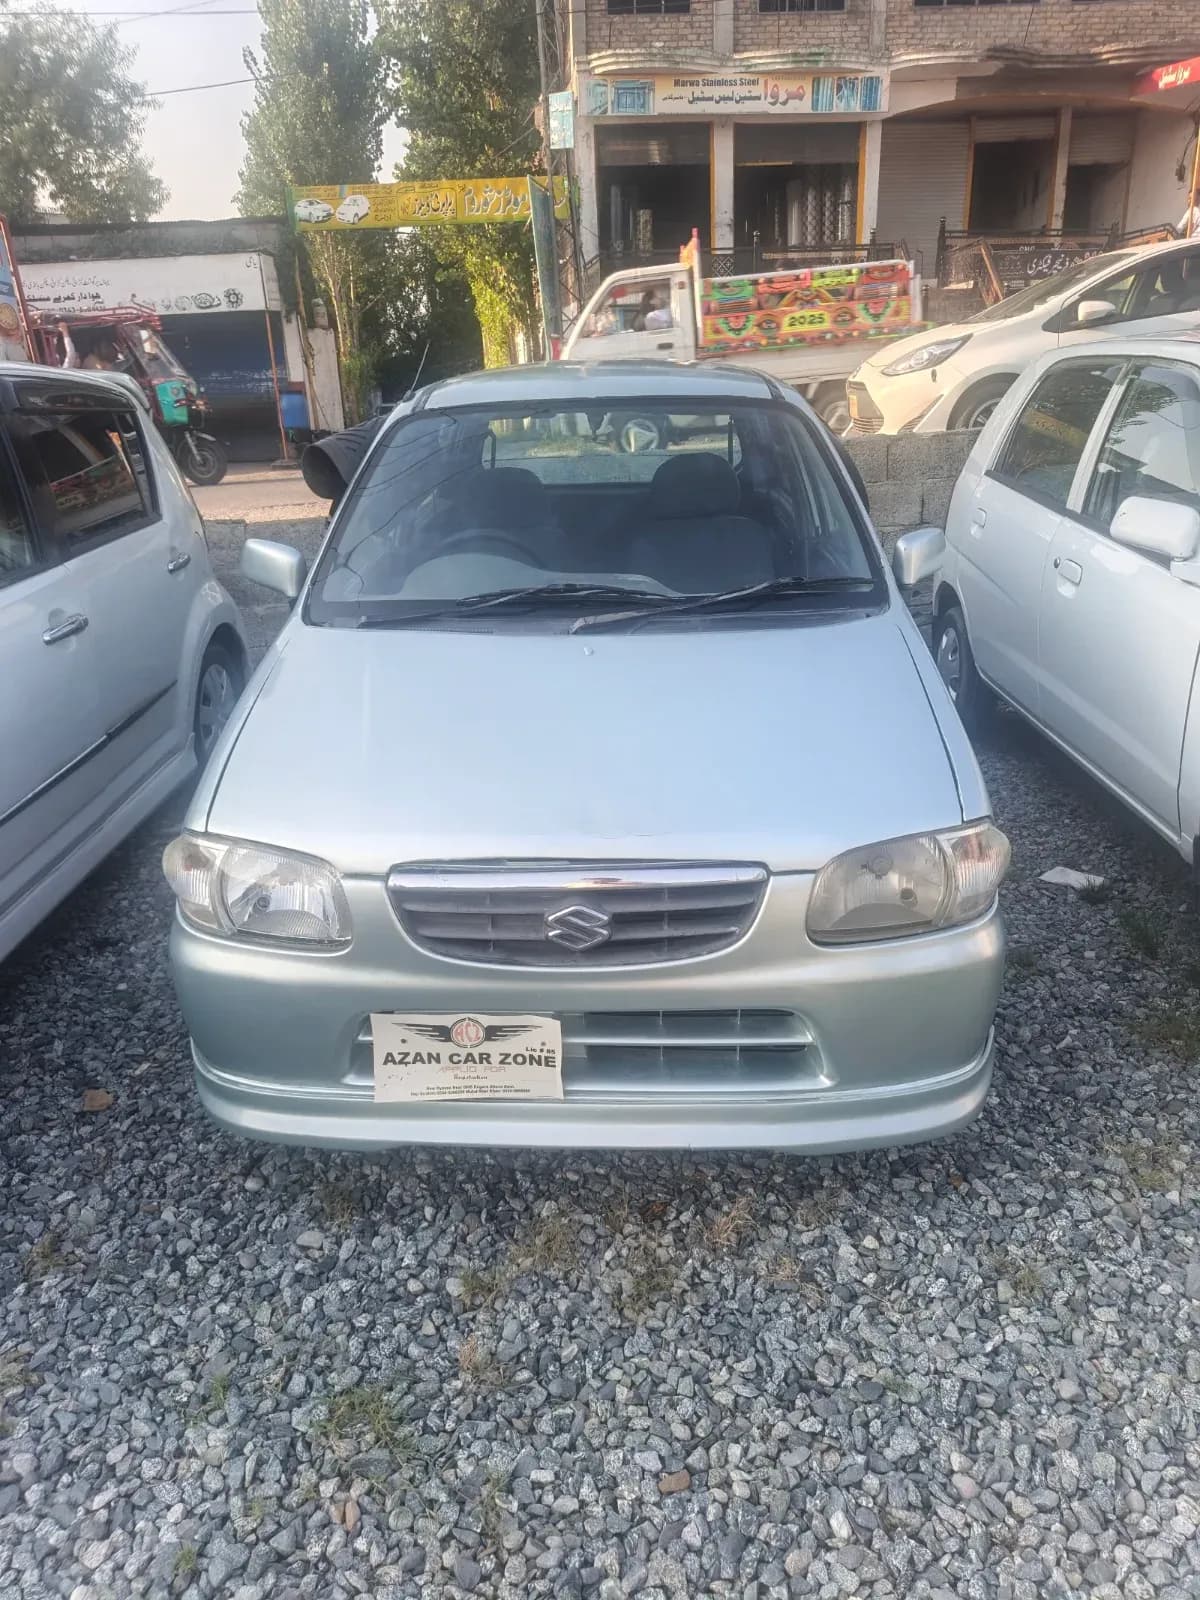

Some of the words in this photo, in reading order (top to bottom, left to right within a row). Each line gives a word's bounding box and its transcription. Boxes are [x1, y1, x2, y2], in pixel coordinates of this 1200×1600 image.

[673, 79, 700, 88] Marwa
[701, 79, 738, 87] Stainless
[739, 78, 760, 87] Steel
[788, 313, 826, 327] 2025
[382, 1051, 441, 1067] AZAN
[448, 1053, 492, 1066] CAR
[498, 1053, 557, 1068] ZONE
